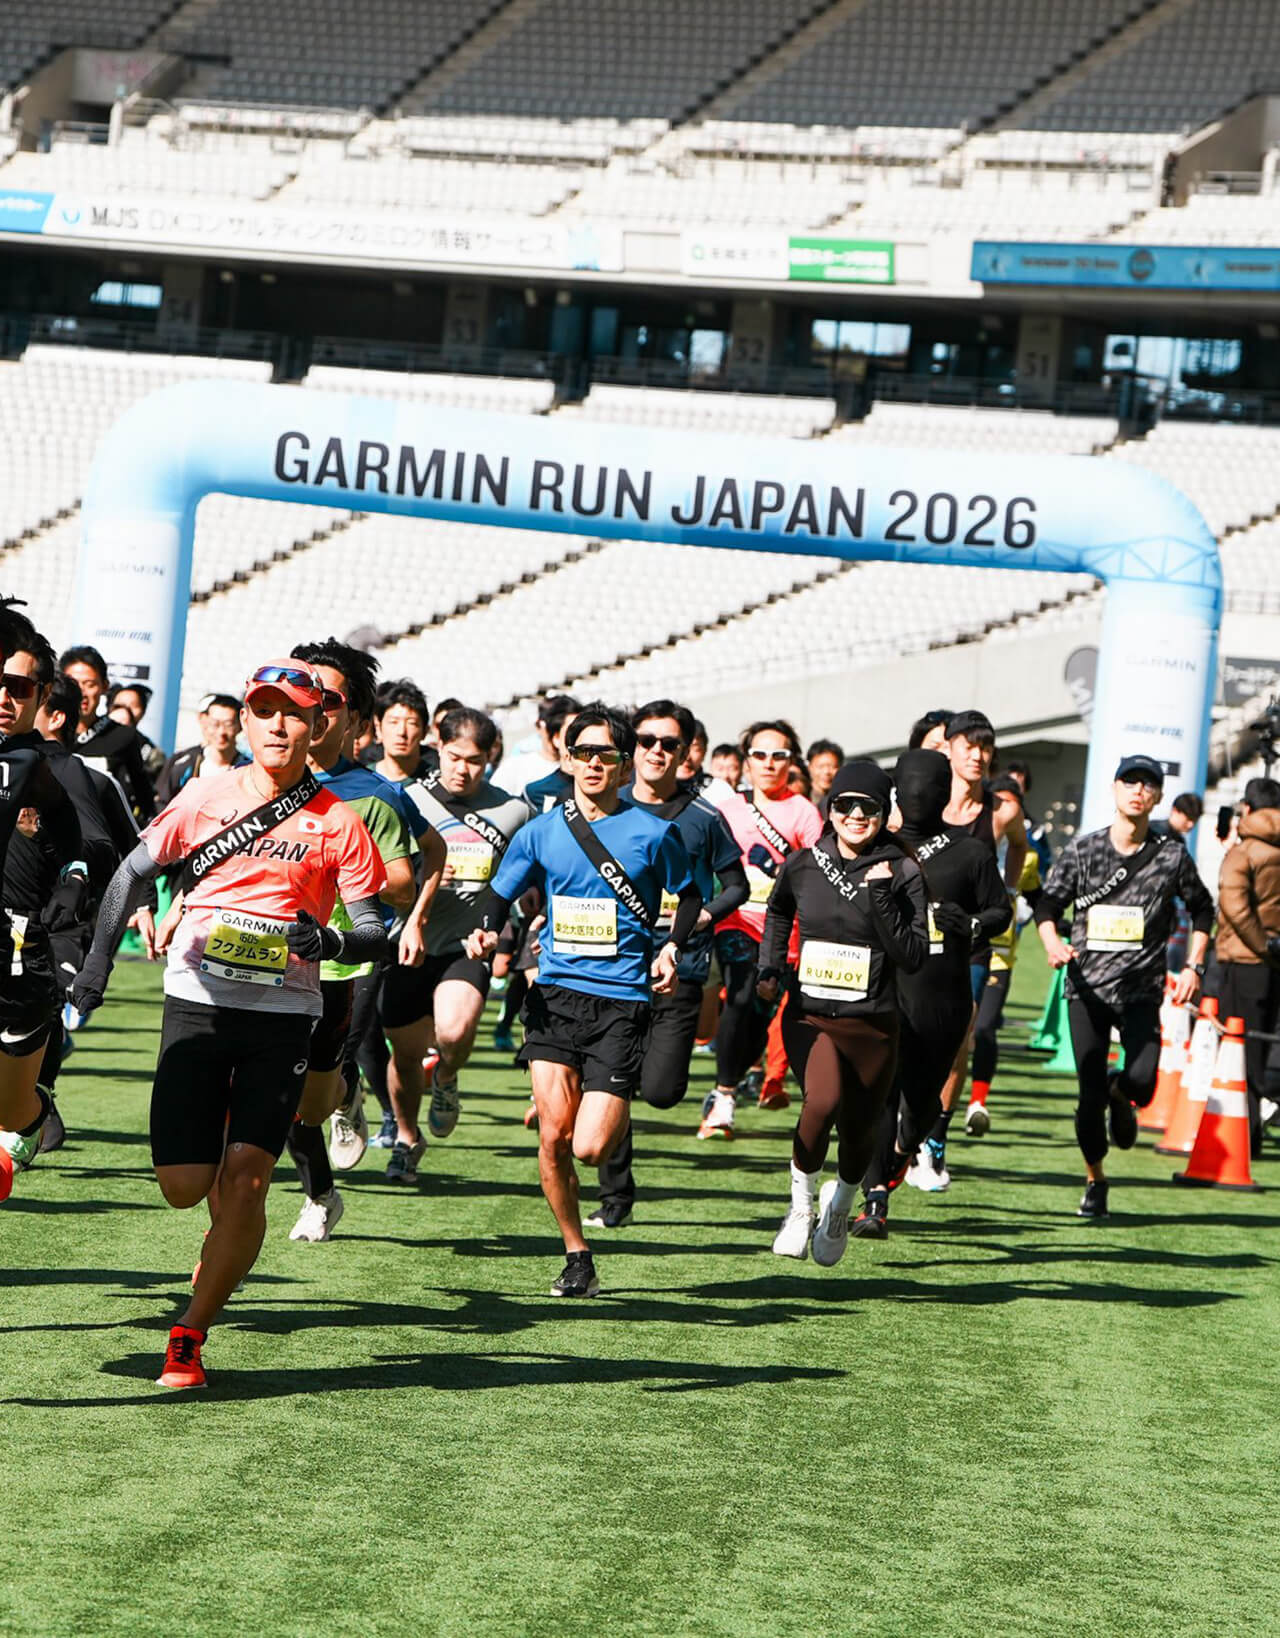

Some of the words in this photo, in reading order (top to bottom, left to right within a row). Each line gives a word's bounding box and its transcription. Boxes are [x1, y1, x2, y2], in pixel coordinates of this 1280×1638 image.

[274, 430, 511, 507] GARMIN
[529, 459, 653, 522] RUN
[671, 474, 866, 539] JAPAN
[884, 489, 1038, 550] 2026
[236, 837, 310, 863] APAN
[1075, 866, 1128, 909] GARMIN
[221, 912, 285, 935] GARMIN
[212, 937, 282, 963] フクシムラン
[806, 966, 864, 984] RUNJOY
